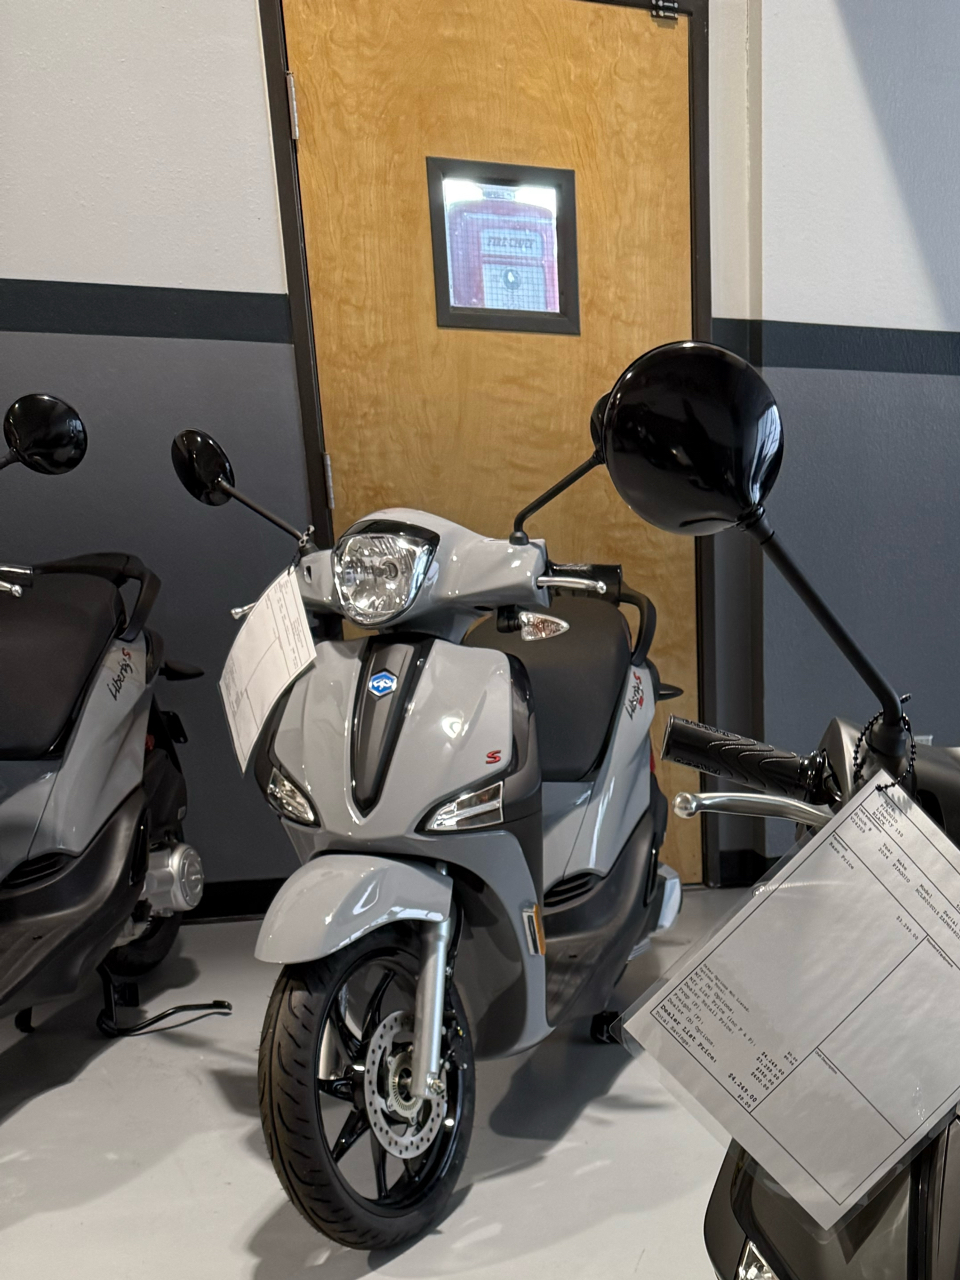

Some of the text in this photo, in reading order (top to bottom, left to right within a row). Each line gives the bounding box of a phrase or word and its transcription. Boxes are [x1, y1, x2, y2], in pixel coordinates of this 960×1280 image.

[485, 749, 502, 765] S
[871, 810, 886, 827] BLACK
[874, 806, 894, 828] Liberty
[878, 803, 899, 824] PIAGGIO
[827, 840, 841, 854] Base
[839, 854, 855, 870] Price
[852, 811, 869, 829] Stock
[881, 842, 893, 855] Year
[895, 858, 908, 871] Make
[918, 883, 933, 899] Model
[941, 909, 959, 927] Serial
[891, 862, 911, 883] PIAGGIO
[671, 991, 693, 1013] Freight
[676, 986, 691, 1001] Prep
[682, 980, 701, 1000] Dealer
[700, 998, 718, 1017] Retail
[697, 986, 711, 999] List
[710, 998, 726, 1015] Price
[666, 996, 685, 1016] Dealer
[654, 1009, 670, 1026] Total
[659, 1003, 758, 1104] Dealer List Price: $4,249.00
